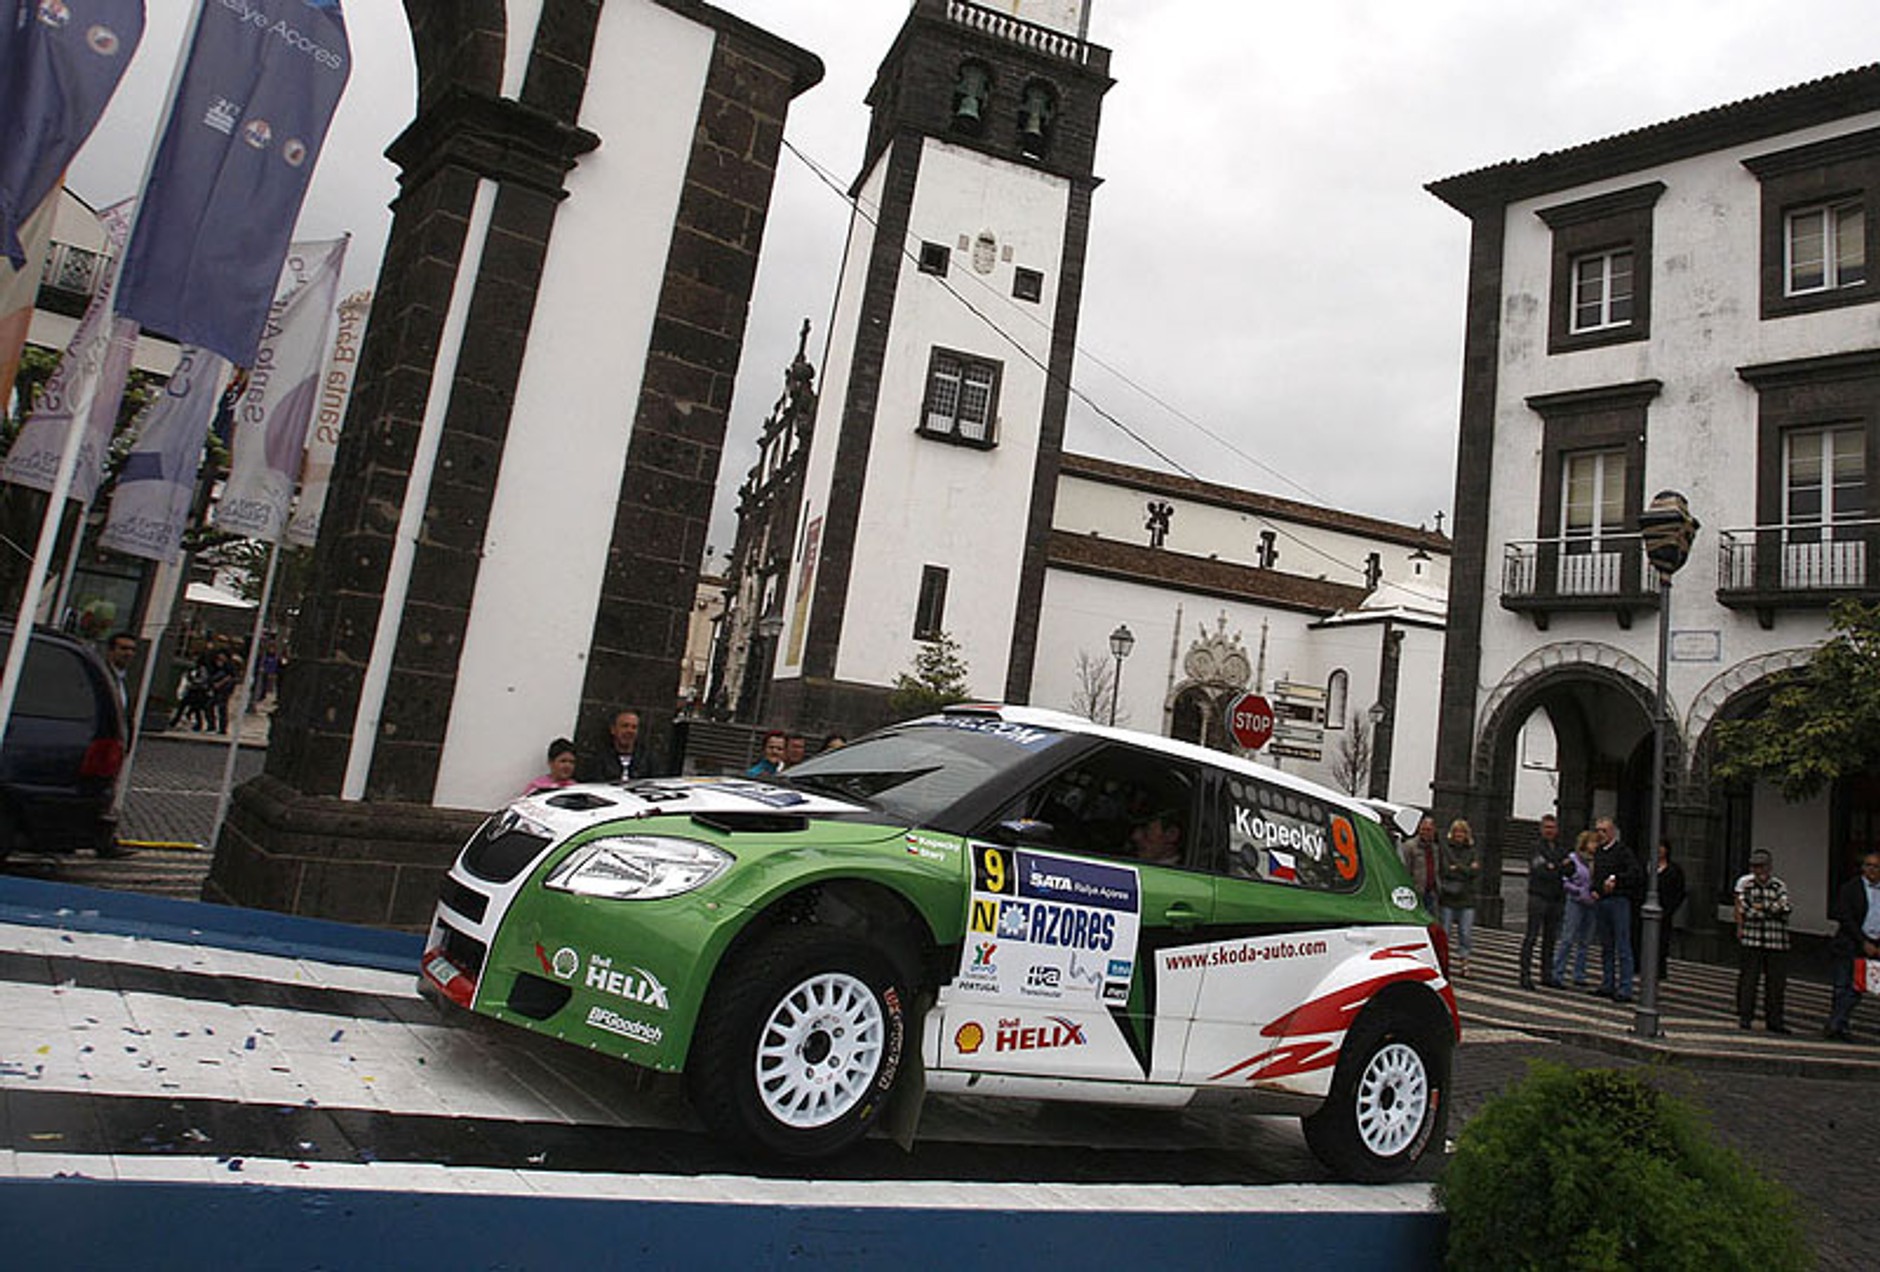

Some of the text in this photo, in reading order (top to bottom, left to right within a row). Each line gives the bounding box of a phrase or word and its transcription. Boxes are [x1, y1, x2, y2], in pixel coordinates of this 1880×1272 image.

[1236, 711, 1271, 733] STOP
[1234, 805, 1323, 862] Kopecký
[1332, 816, 1358, 880] 9
[984, 848, 1005, 893] 9
[1029, 873, 1073, 892] SATA
[971, 902, 997, 932] N
[1165, 940, 1327, 970] www.skoda-auto.com
[585, 966, 669, 1010] HELIX
[587, 1006, 663, 1042] BFGoodrich
[995, 1018, 1085, 1052] HELIX
